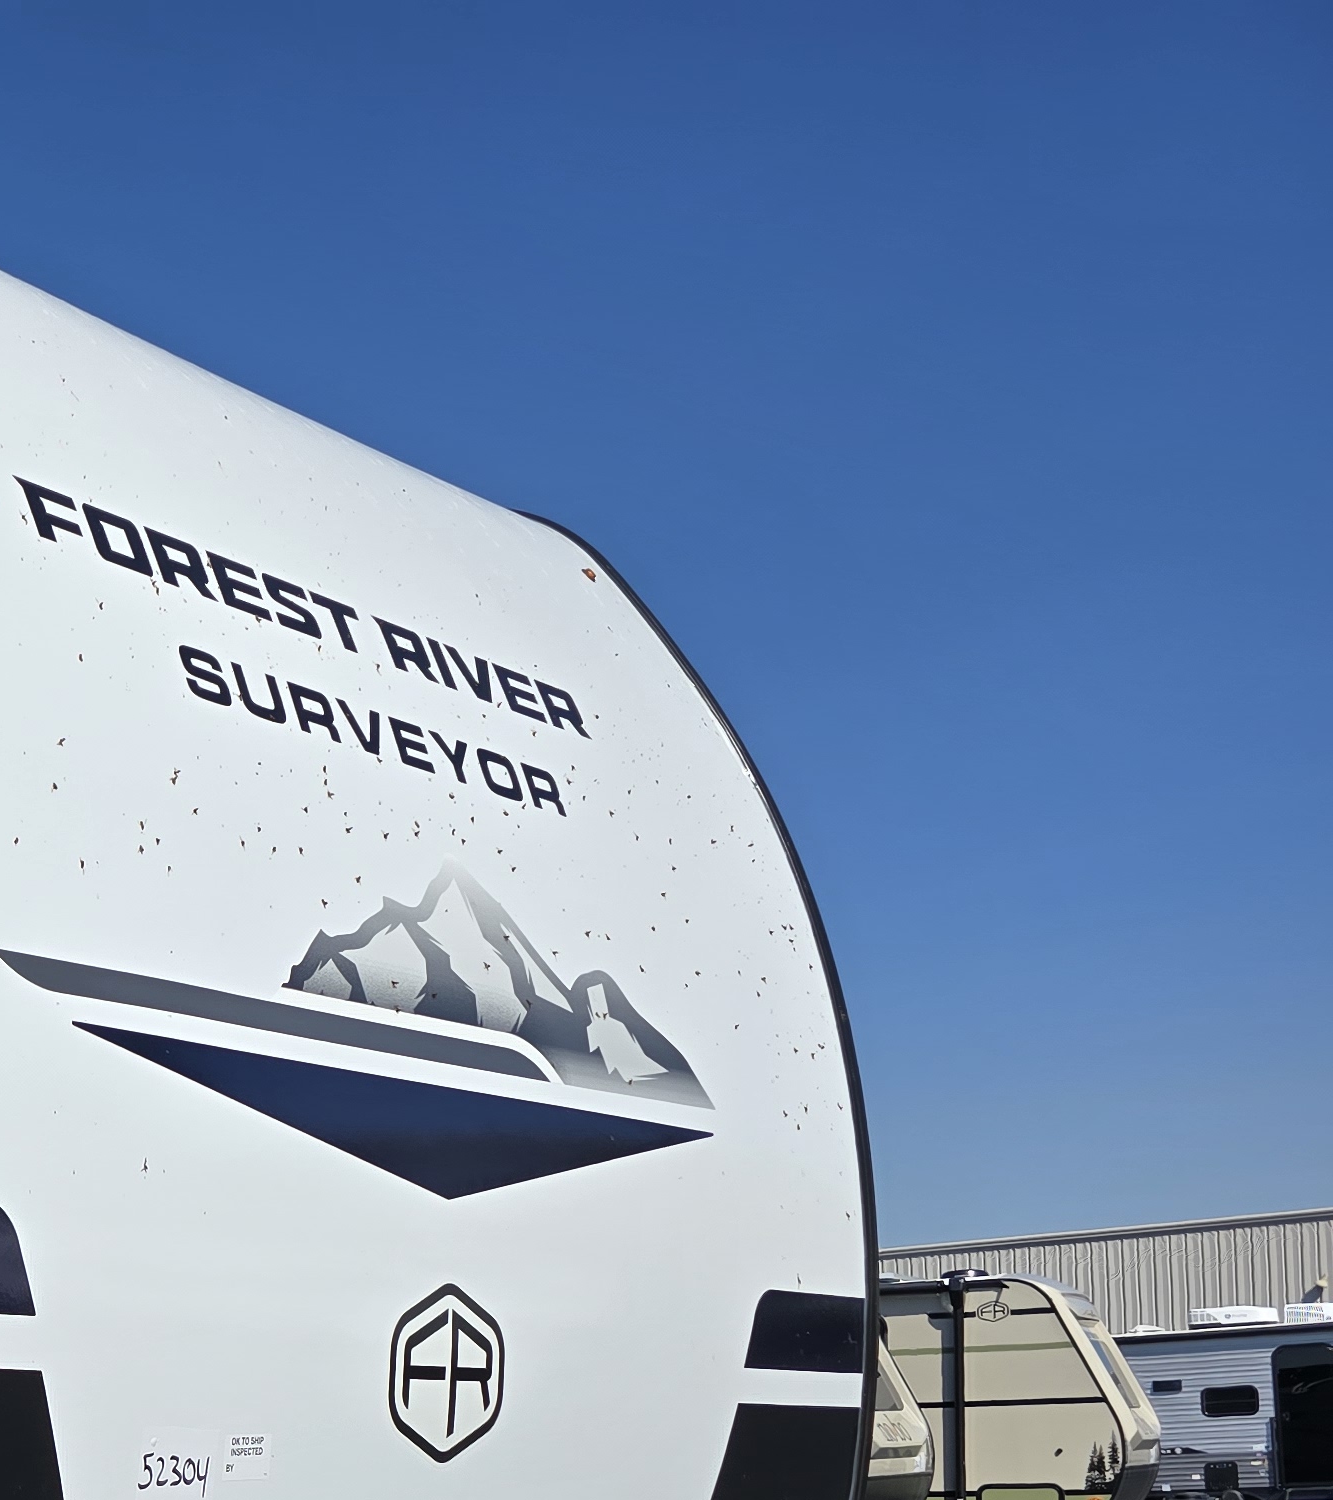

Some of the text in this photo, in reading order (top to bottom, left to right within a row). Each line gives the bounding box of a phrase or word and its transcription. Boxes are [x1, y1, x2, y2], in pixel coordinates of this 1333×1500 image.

[11, 475, 593, 740] FOREST RIVER
[177, 644, 568, 818] SURVEYOR
[230, 1447, 264, 1457] INSPECTED
[231, 1436, 265, 1446] OK TO SHIP
[137, 1451, 212, 1498] 52304
[225, 1463, 235, 1473] BY
